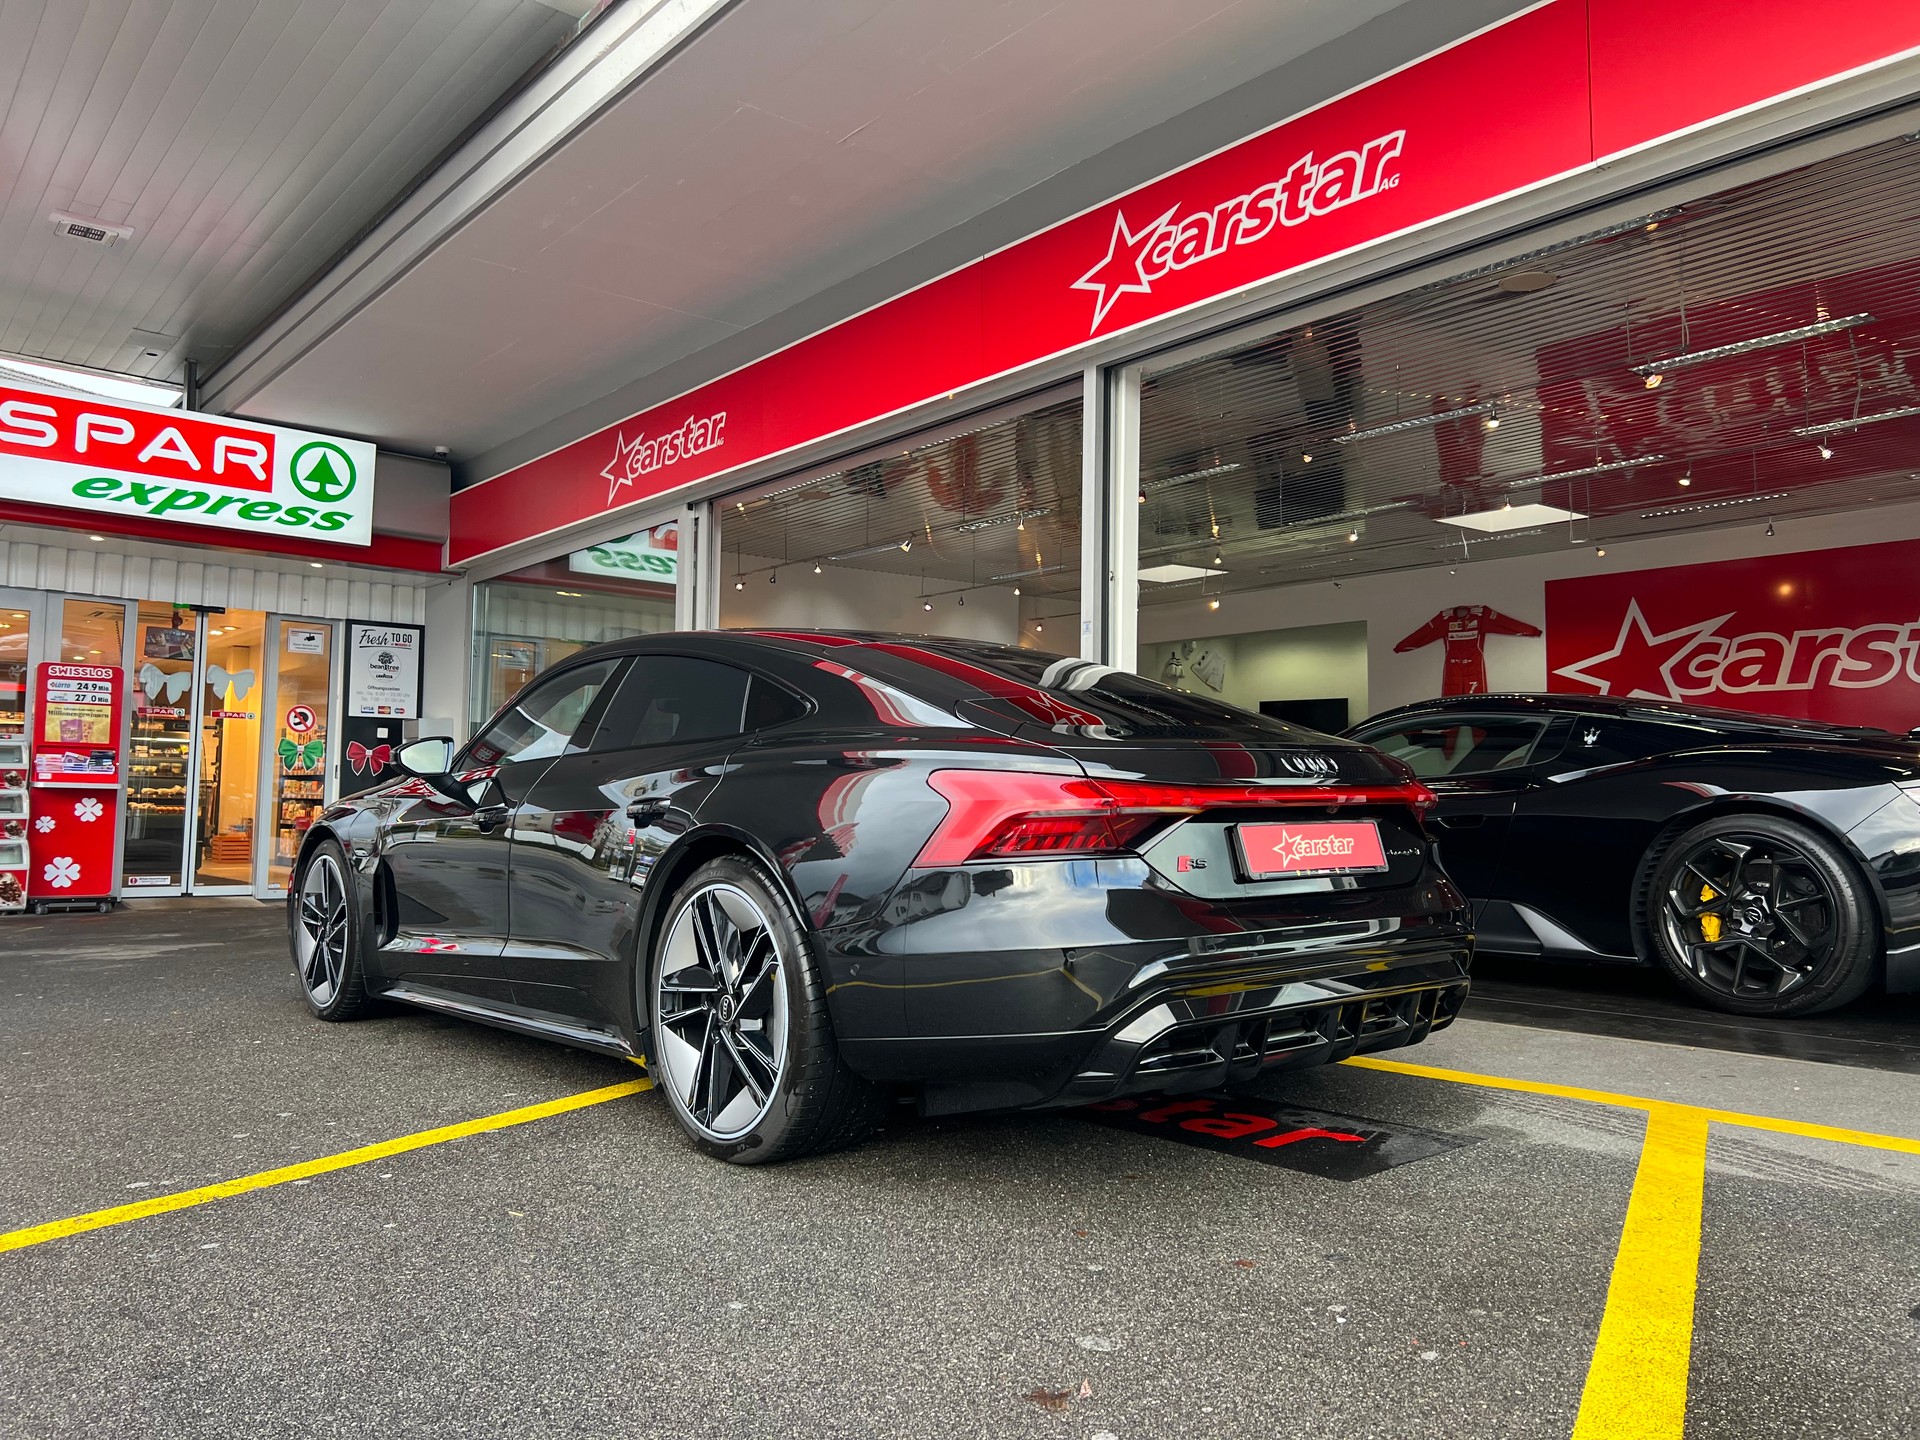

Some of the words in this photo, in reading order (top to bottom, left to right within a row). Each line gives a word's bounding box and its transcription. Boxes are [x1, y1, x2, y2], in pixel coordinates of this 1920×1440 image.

[1136, 129, 1406, 281] carstar
[1378, 172, 1400, 193] AG
[0, 400, 268, 481] SPAR
[628, 411, 727, 479] carstar
[716, 437, 725, 446] AG
[71, 476, 355, 531] express
[358, 629, 389, 645] Fresh
[391, 632, 401, 643] TO
[402, 634, 412, 644] GO
[49, 666, 112, 678] SWISSLOS
[1468, 681, 1478, 694] 7
[1294, 834, 1354, 858] carstar
[1177, 855, 1207, 873] RS
